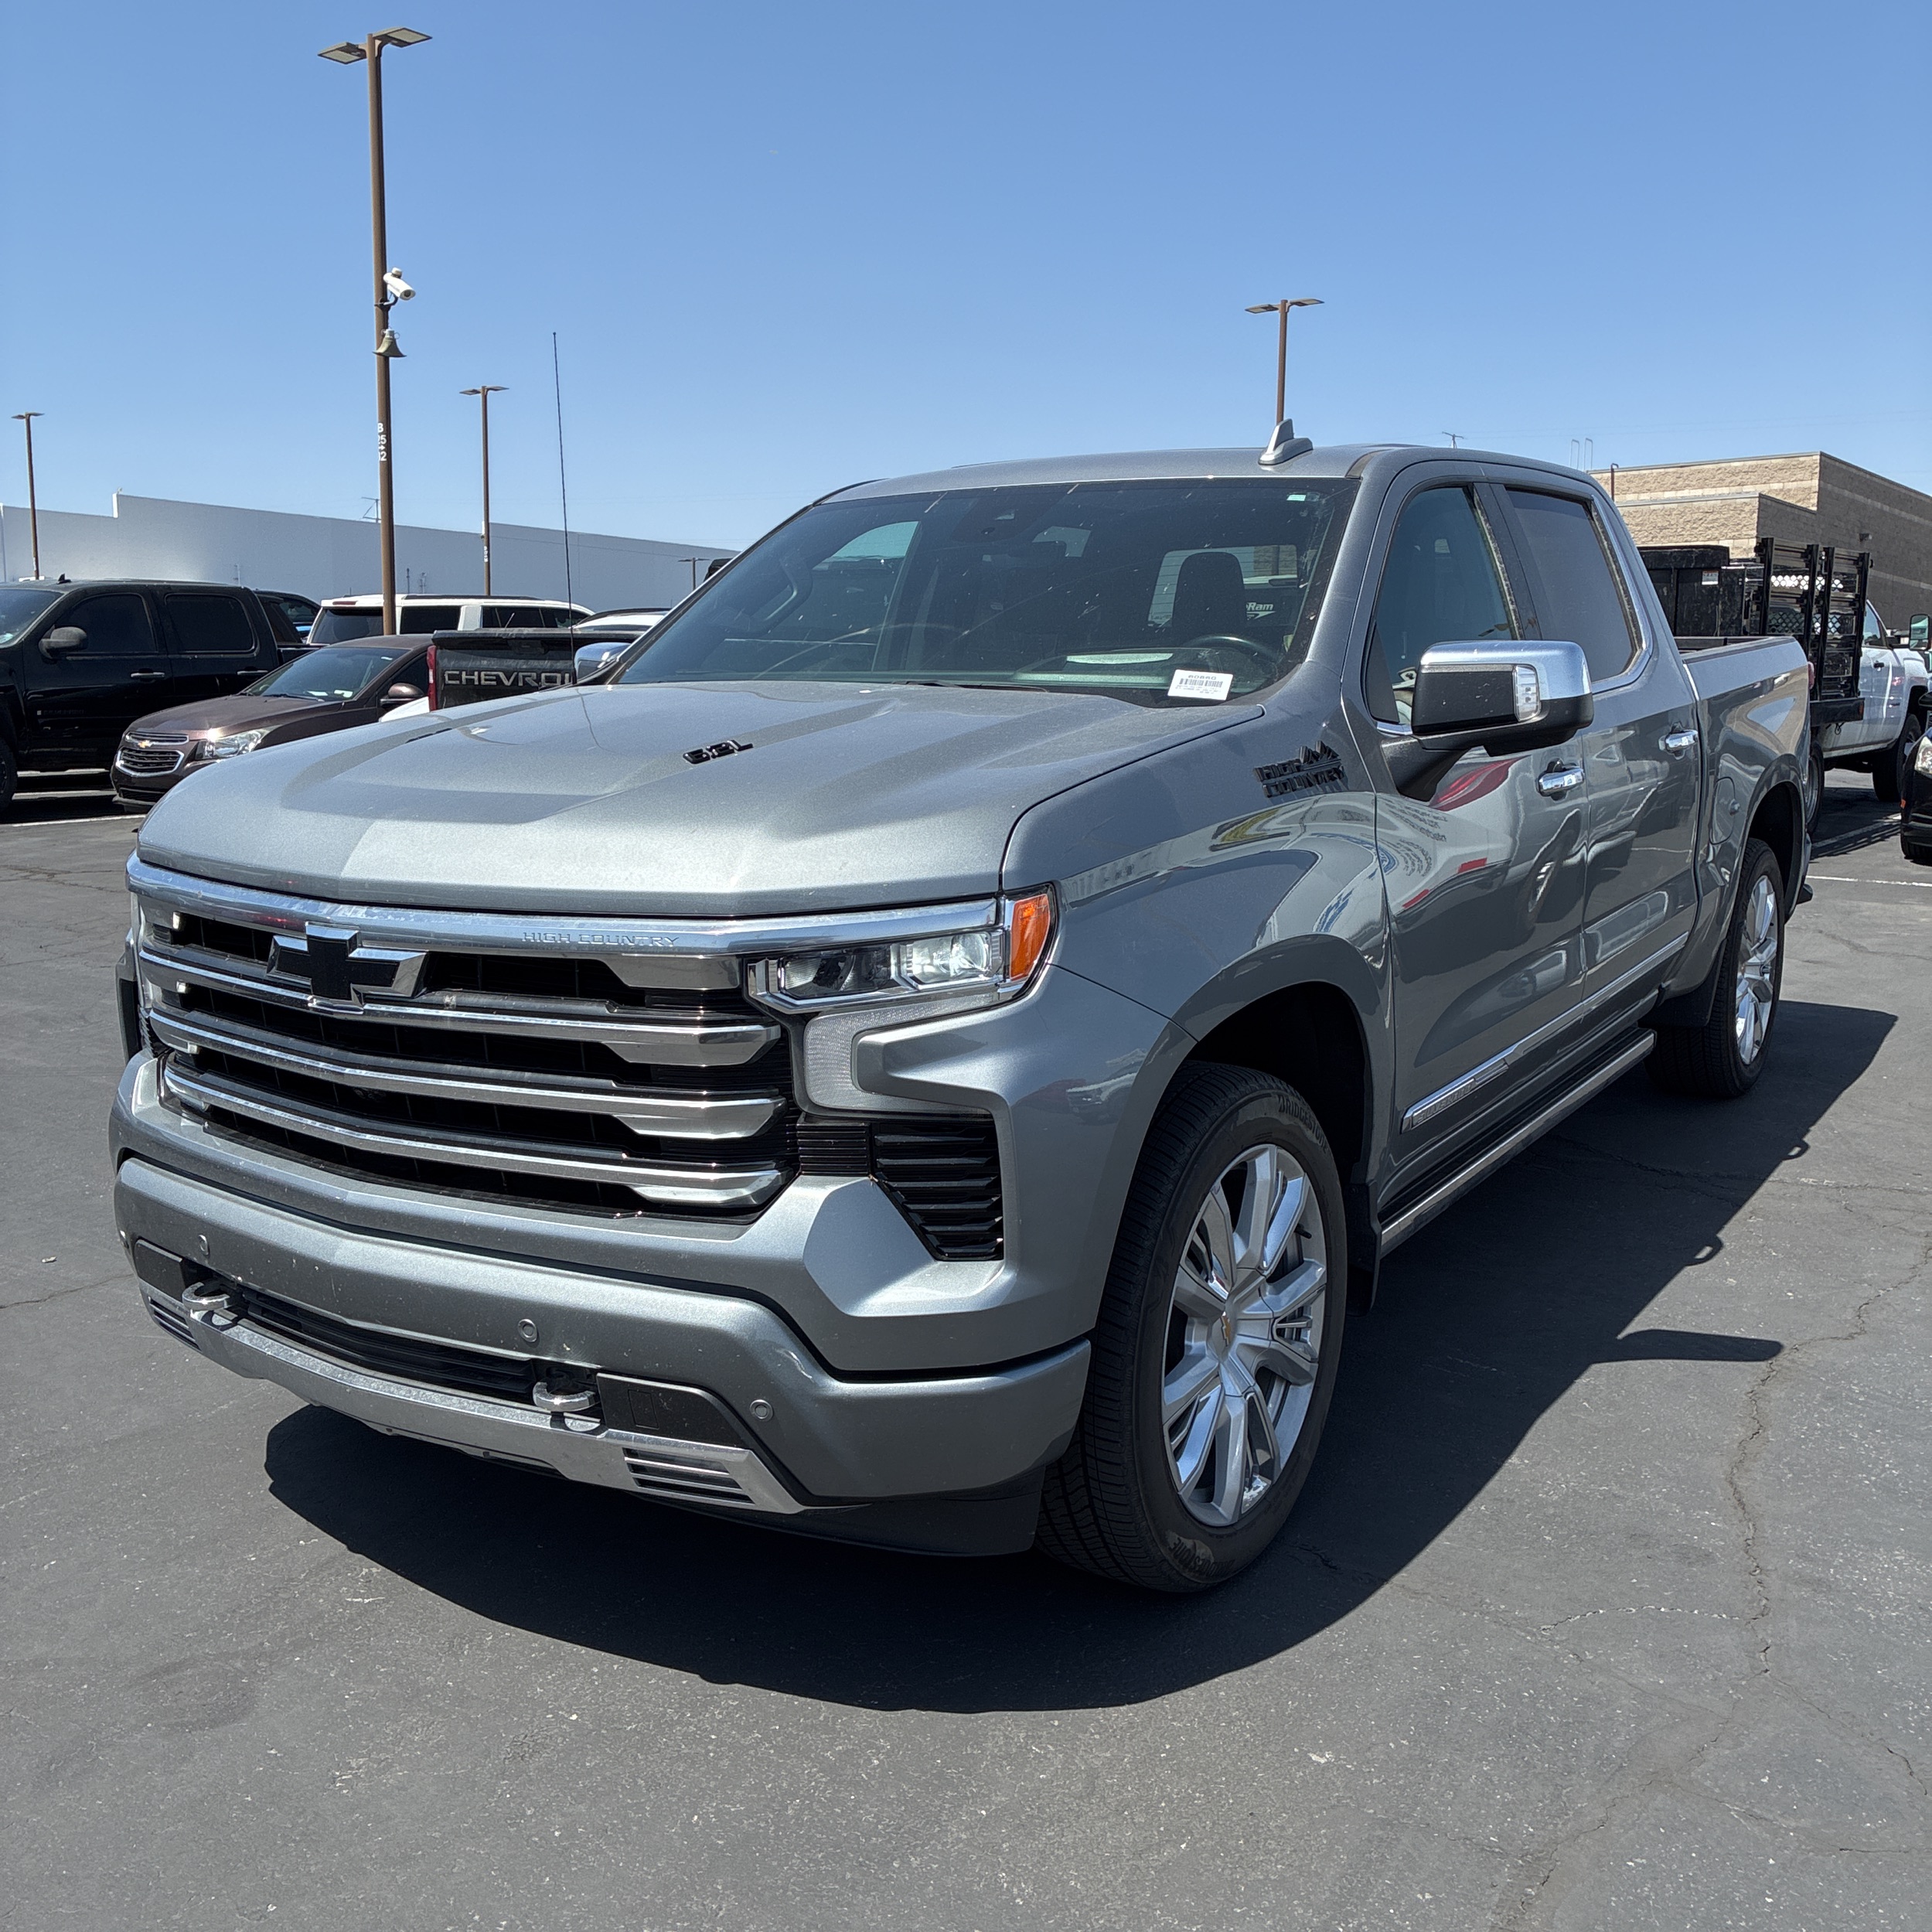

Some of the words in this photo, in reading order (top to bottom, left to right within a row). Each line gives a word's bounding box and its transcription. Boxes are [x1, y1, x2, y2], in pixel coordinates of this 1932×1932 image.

[377, 422, 384, 433] B
[1245, 601, 1274, 611] Ram
[1262, 765, 1346, 799] COUNTRY
[521, 932, 571, 944] HIGH
[578, 933, 680, 948] COUNTRY
[1277, 1094, 1328, 1154] BRIDGESTONE
